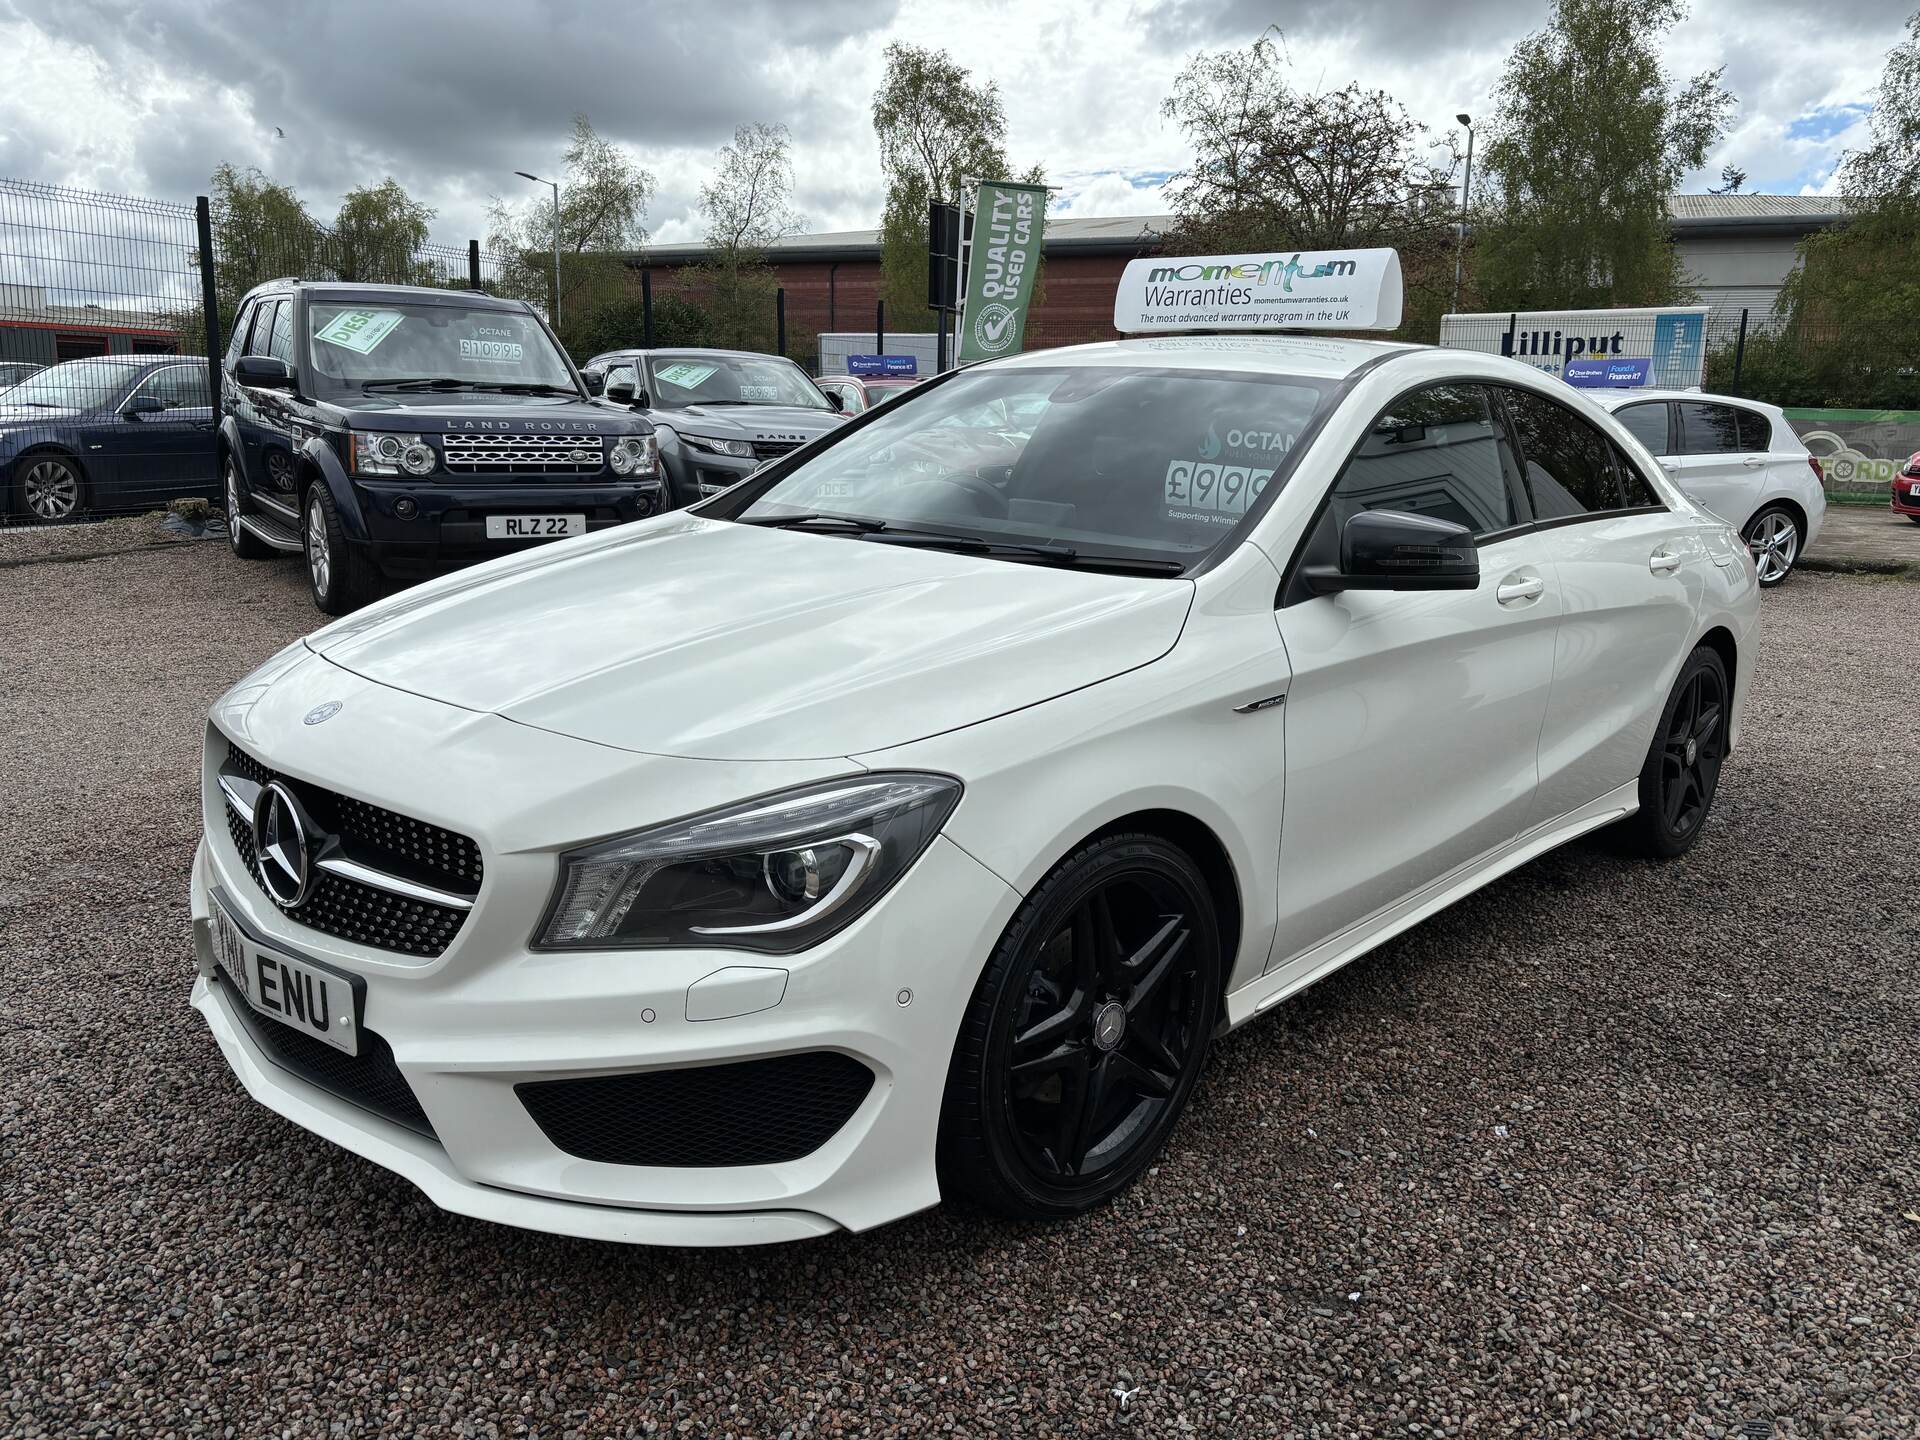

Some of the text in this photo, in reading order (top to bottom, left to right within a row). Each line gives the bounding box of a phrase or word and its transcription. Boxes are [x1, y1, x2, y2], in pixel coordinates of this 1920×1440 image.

[983, 190, 1013, 298] QUALITY
[1003, 192, 1032, 300] USED CARS
[1148, 254, 1356, 292] momentum
[1145, 283, 1349, 306] Warranties momentumwarranties.co.uk
[1140, 309, 1350, 324] The most advanced warranty program in the UK
[479, 327, 512, 337] OCTANE
[461, 340, 521, 359] £10995
[1502, 330, 1624, 365] Lilliput
[1632, 372, 1641, 380] it?
[447, 421, 598, 431] LAND ROVER
[1168, 510, 1210, 523] Supporting
[506, 518, 568, 535] RLZ 22
[256, 953, 329, 1032] ENU
